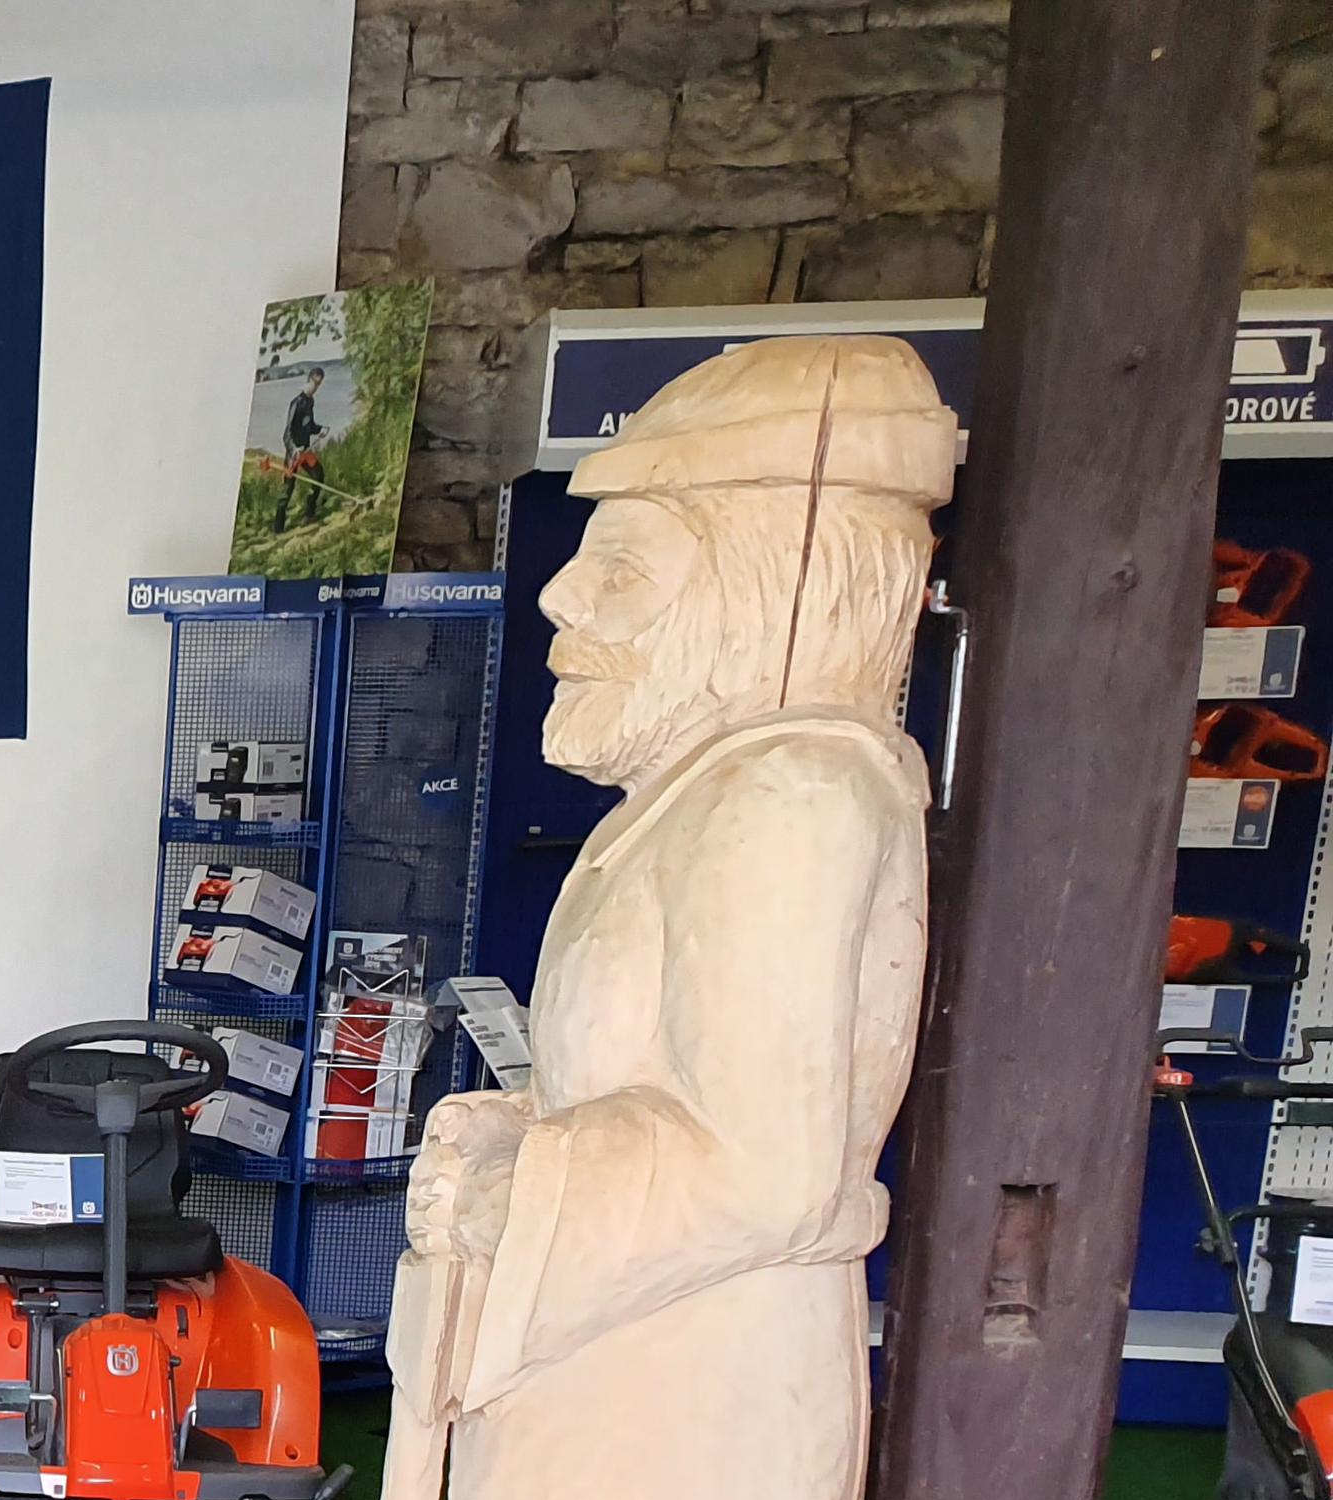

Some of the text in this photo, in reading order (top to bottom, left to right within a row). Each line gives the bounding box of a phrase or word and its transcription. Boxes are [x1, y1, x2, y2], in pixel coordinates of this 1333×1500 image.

[154, 585, 261, 606] Husqvarna
[390, 584, 502, 603] Husqvarna
[422, 778, 460, 793] AKCE
